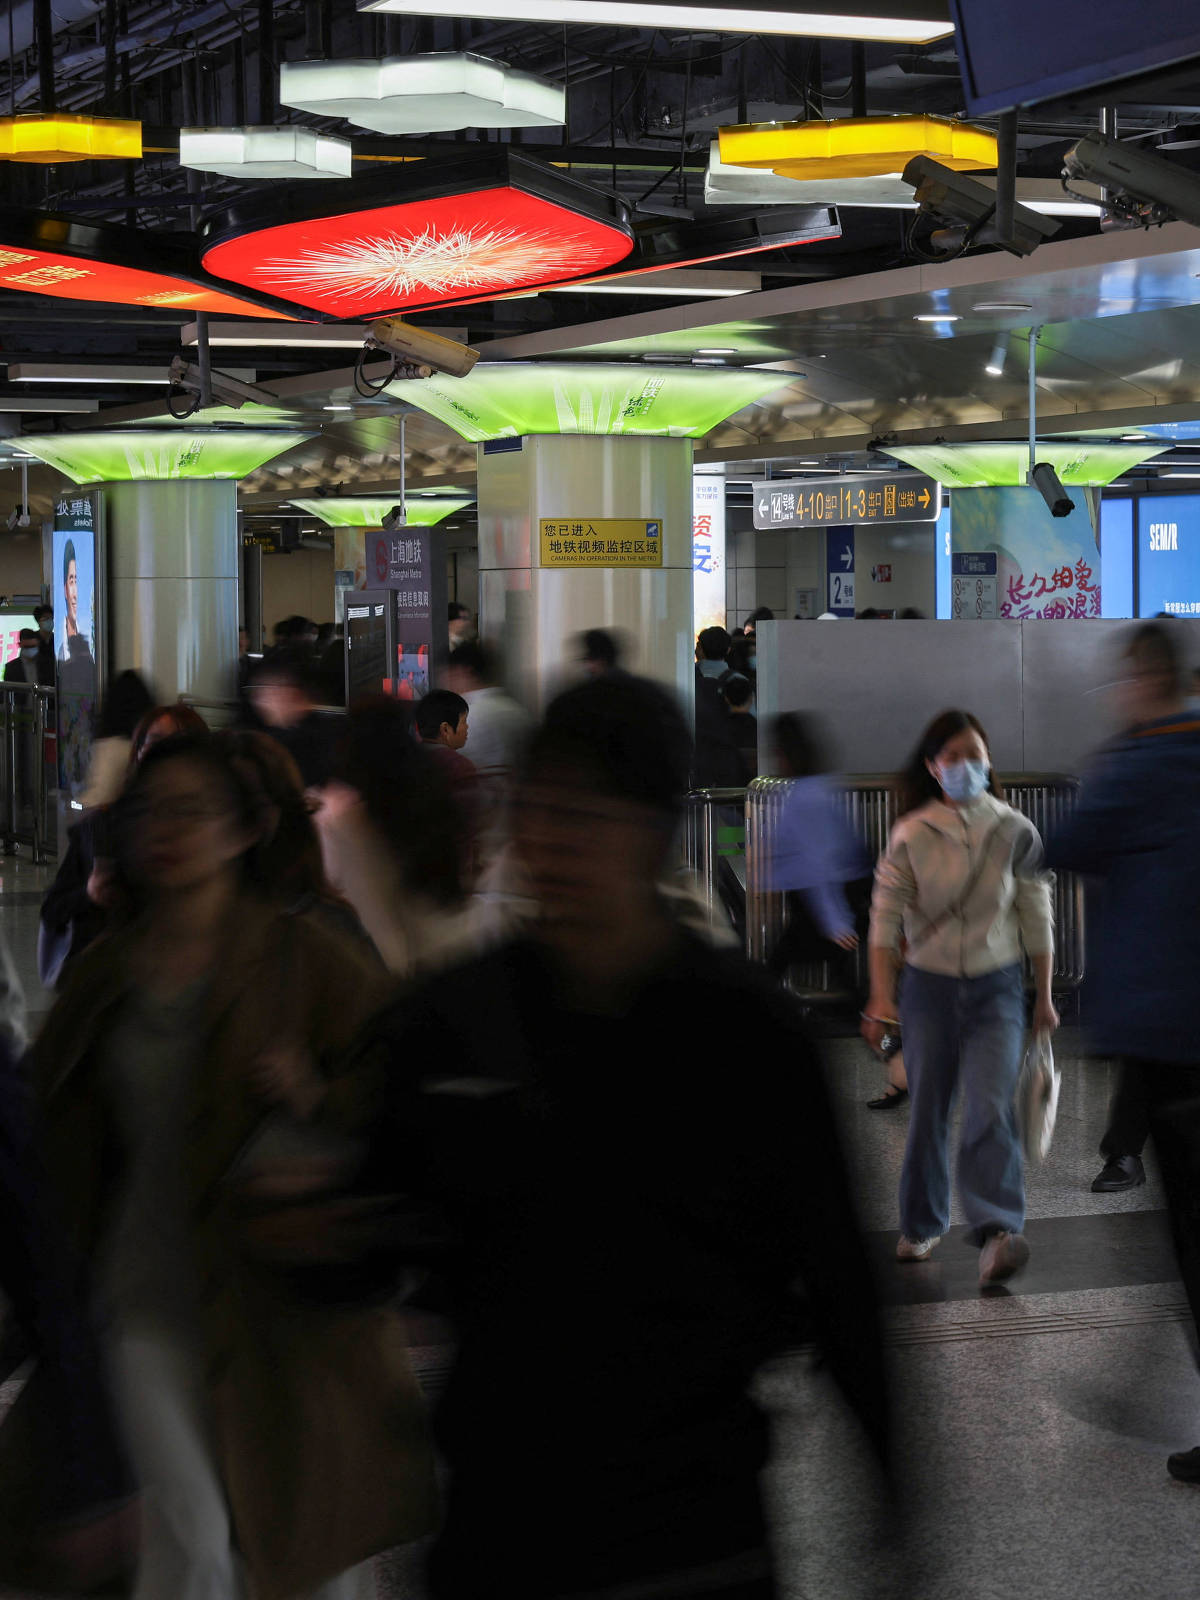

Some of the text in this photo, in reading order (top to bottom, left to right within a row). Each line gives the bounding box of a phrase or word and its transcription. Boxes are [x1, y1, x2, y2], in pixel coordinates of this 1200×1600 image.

[771, 496, 782, 519] 14
[796, 492, 824, 520] 4-10
[825, 494, 838, 511] 出口
[845, 488, 866, 518] 1-3
[868, 491, 882, 507] 出口
[544, 524, 597, 537] 您已进入
[390, 538, 422, 565] 上海地铁
[549, 540, 658, 554] 地铁视频监控区域
[390, 569, 422, 581] Shanghai Metro
[1007, 556, 1097, 605] 长久的爱
[834, 576, 842, 604] 2
